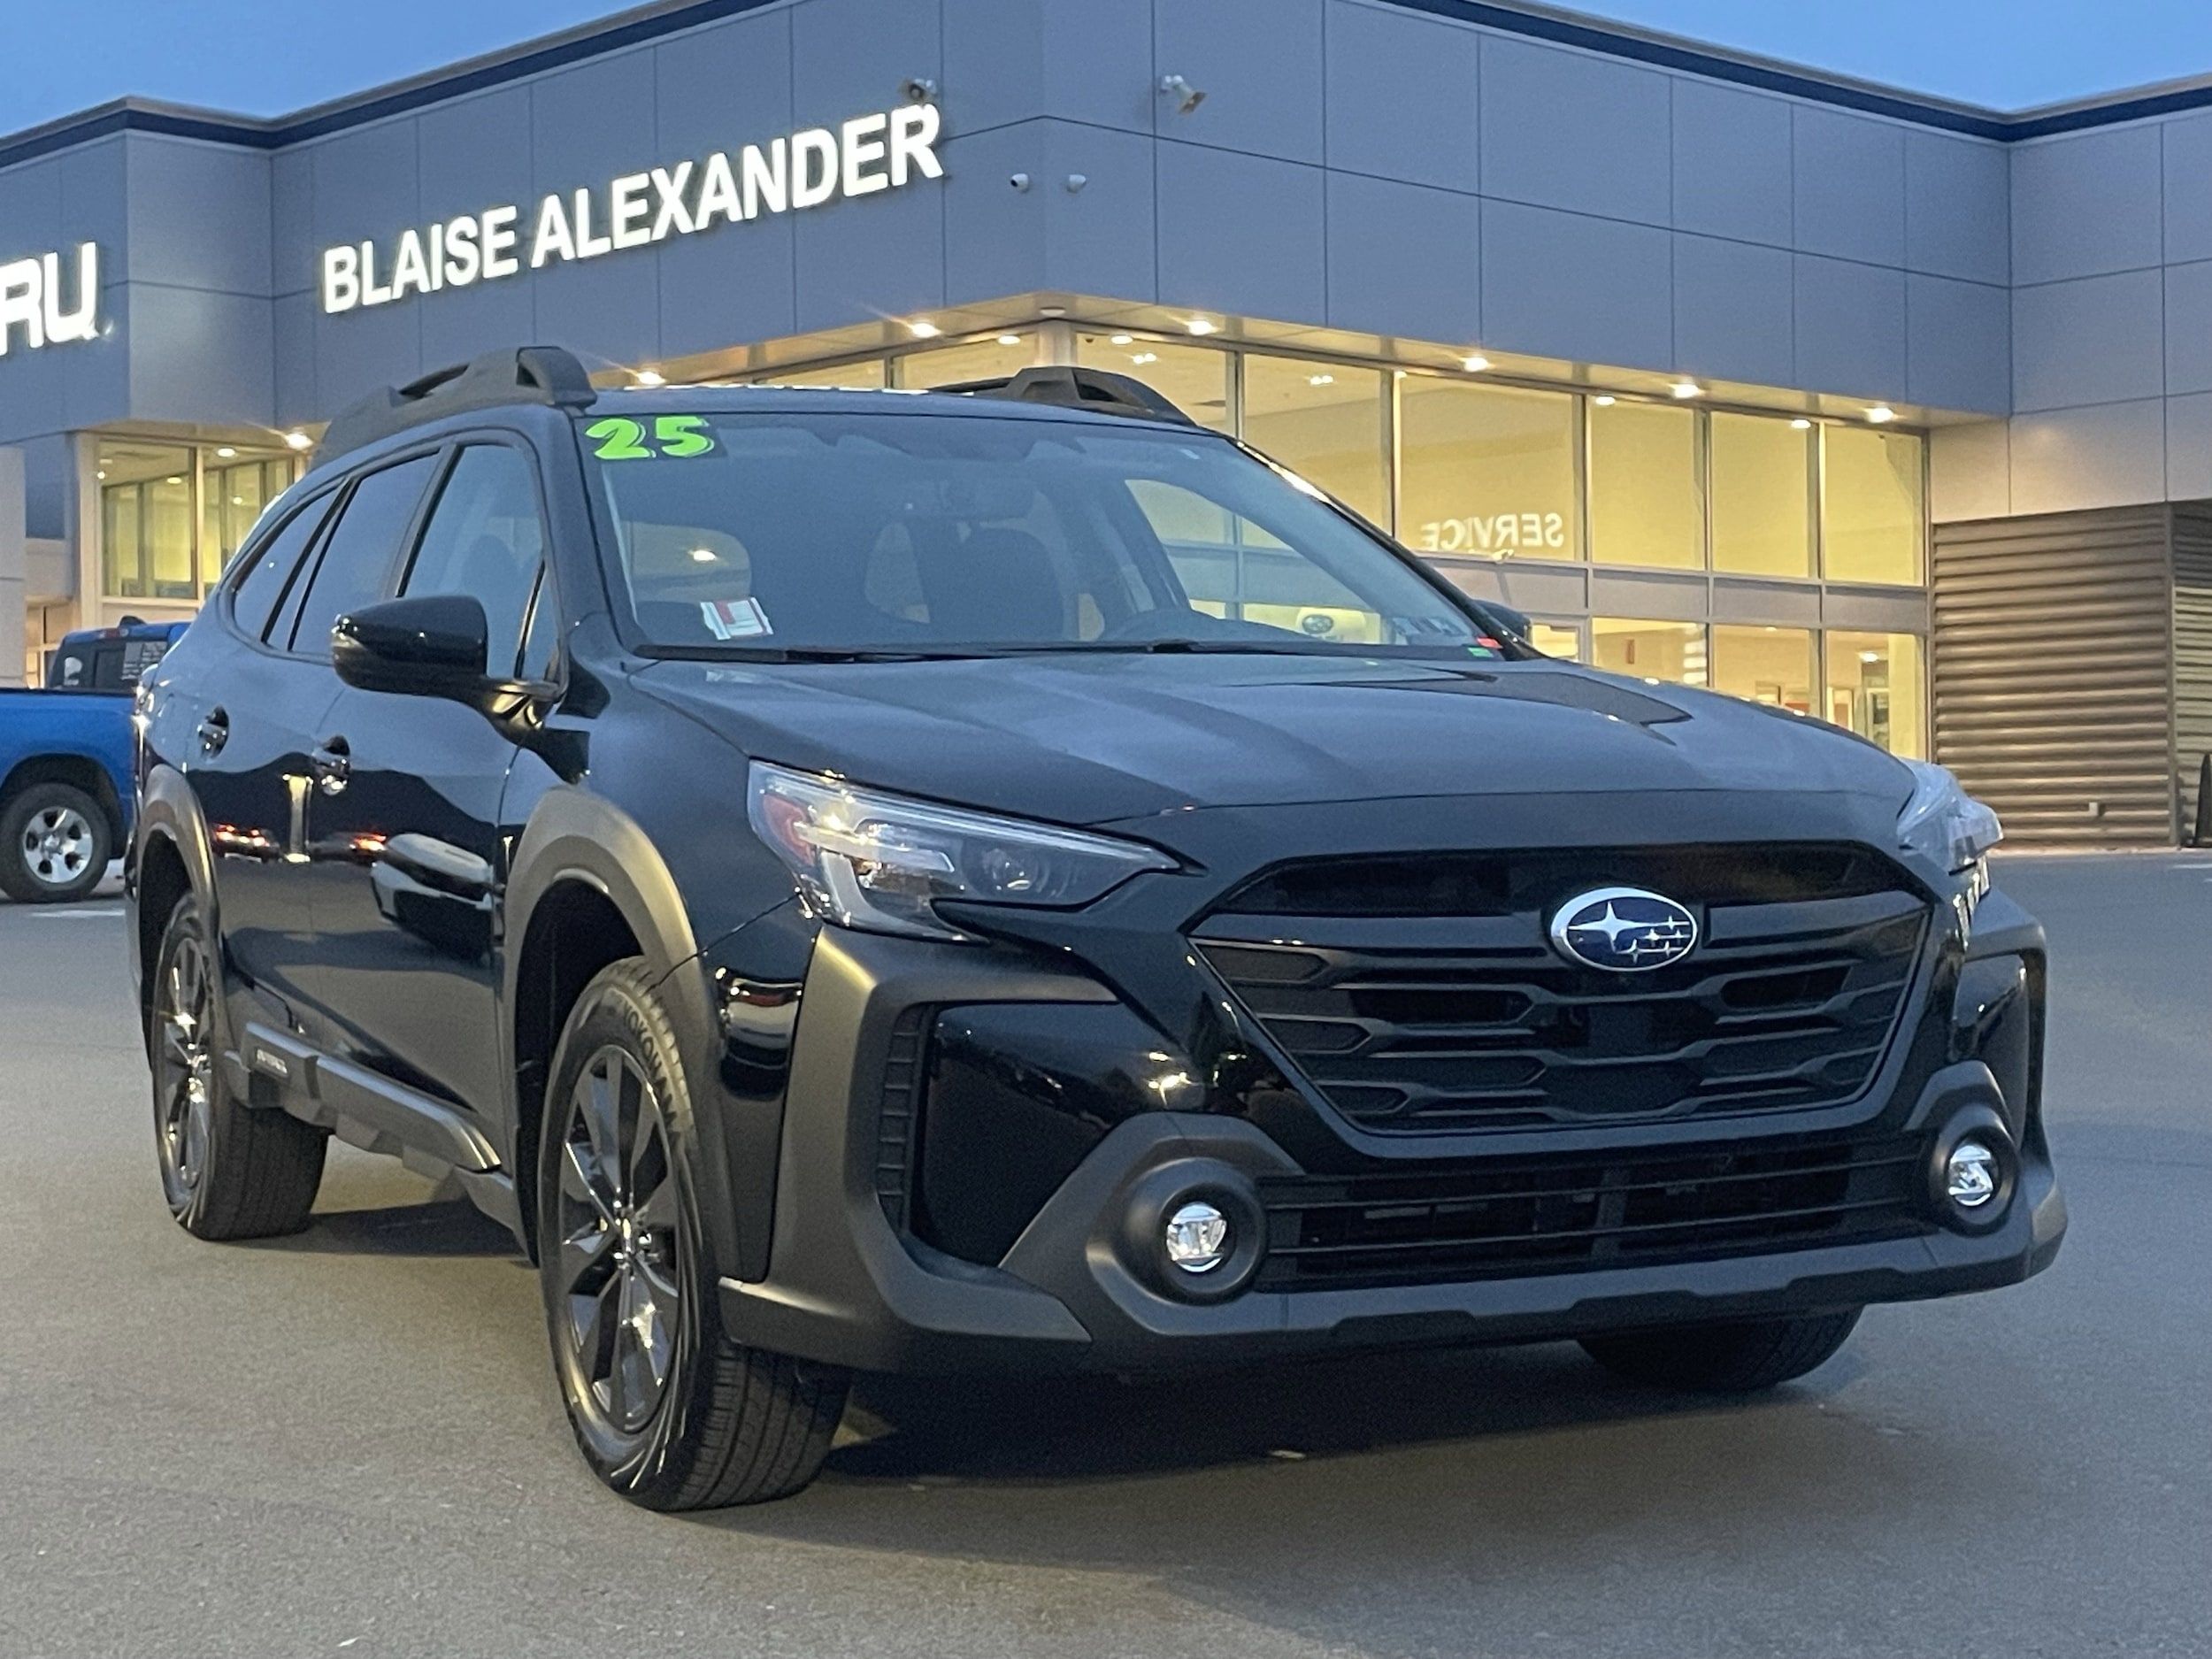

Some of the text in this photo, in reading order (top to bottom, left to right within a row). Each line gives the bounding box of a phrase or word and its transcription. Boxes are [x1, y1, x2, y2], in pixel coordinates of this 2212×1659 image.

[324, 104, 943, 313] BLAISE ALEXANDER
[585, 416, 715, 459] 25
